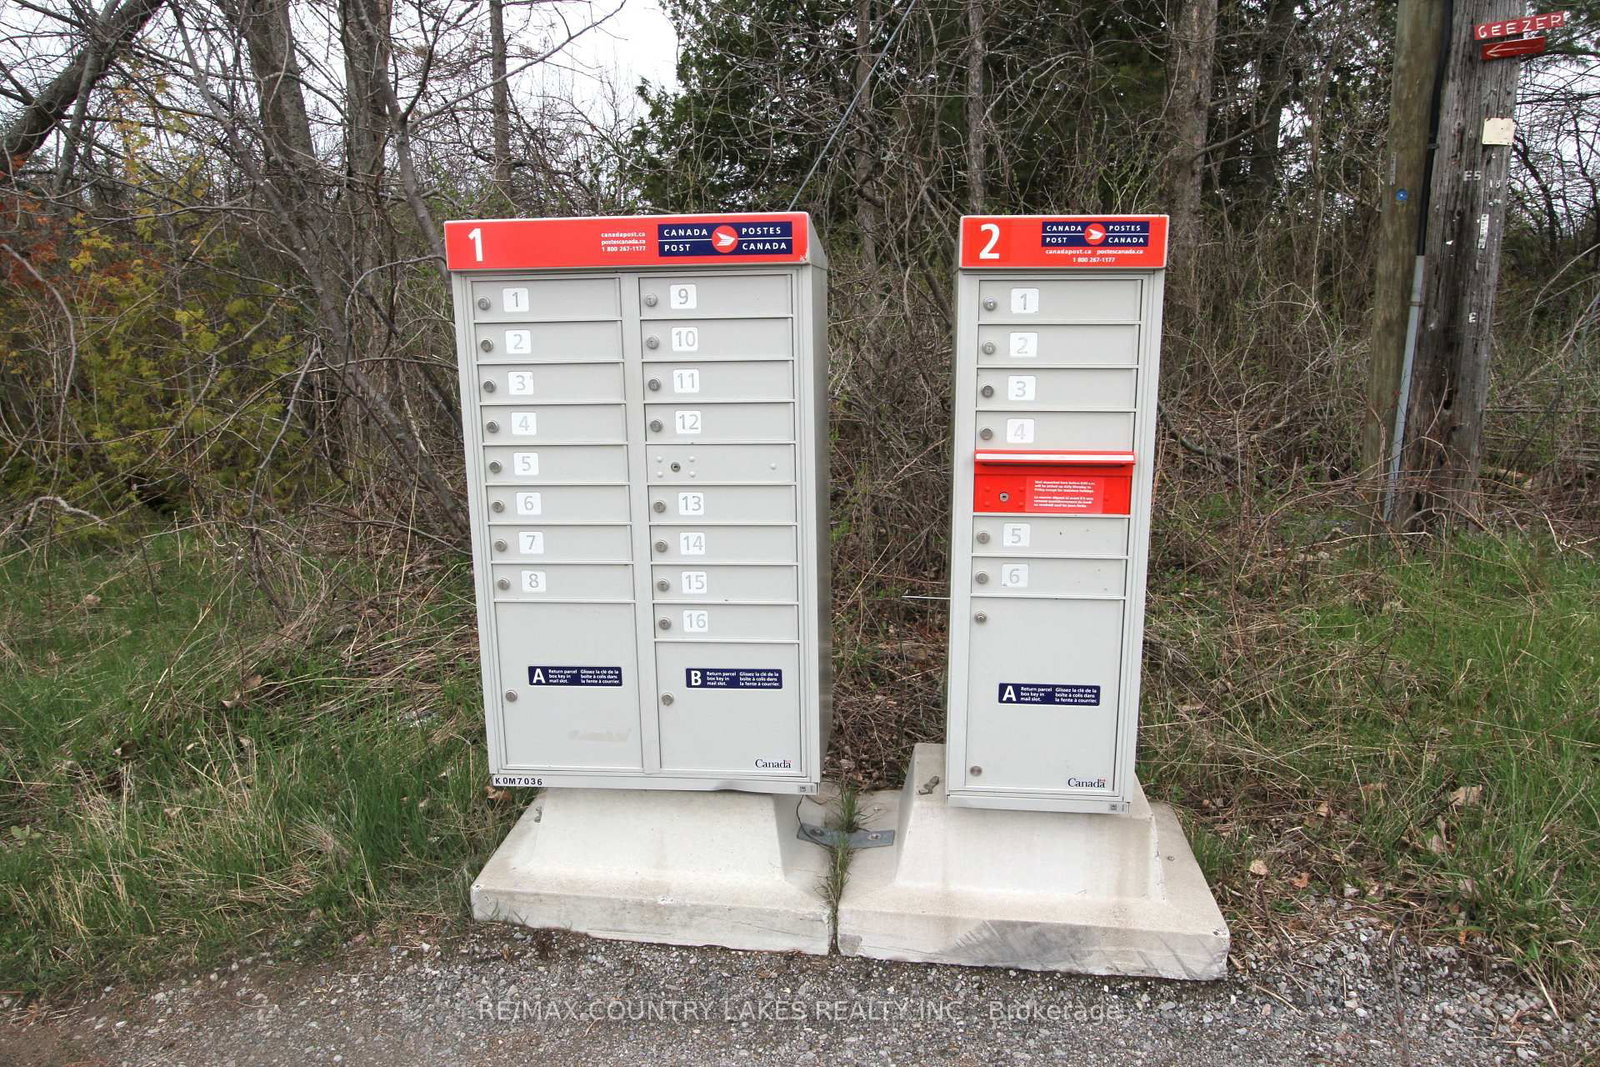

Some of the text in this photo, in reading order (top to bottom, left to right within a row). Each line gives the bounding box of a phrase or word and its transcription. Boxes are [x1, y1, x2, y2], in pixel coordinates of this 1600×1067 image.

[1478, 15, 1562, 38] GEEZER
[664, 228, 708, 237] CANADA
[742, 227, 781, 235] POSTES
[467, 227, 484, 262] 1
[664, 243, 691, 252] POST
[742, 242, 787, 251] CANADA
[978, 223, 1000, 260] 2
[1108, 236, 1145, 244] CANADA
[512, 291, 519, 308] 1
[678, 288, 688, 305] 9
[1020, 293, 1027, 310] 1
[513, 333, 524, 350] 2
[675, 330, 696, 347] 10
[1016, 336, 1028, 354] 2
[516, 374, 526, 391] 3
[677, 372, 696, 389] 11
[1015, 381, 1026, 398] 3
[518, 415, 530, 431] 4
[679, 414, 699, 430] 12
[1013, 423, 1026, 440] 4
[521, 455, 532, 472] 5
[523, 495, 534, 511] 6
[681, 496, 702, 512] 13
[526, 535, 536, 550] 7
[682, 535, 703, 551] 14
[1011, 528, 1022, 544] 5
[529, 573, 539, 589] 8
[685, 574, 705, 590] 15
[1009, 568, 1020, 584] 6
[686, 613, 706, 629] 16
[532, 668, 546, 684] A
[690, 670, 702, 686] B
[1002, 685, 1017, 702] A
[755, 758, 792, 769] Canada
[1067, 777, 1106, 788] Canada
